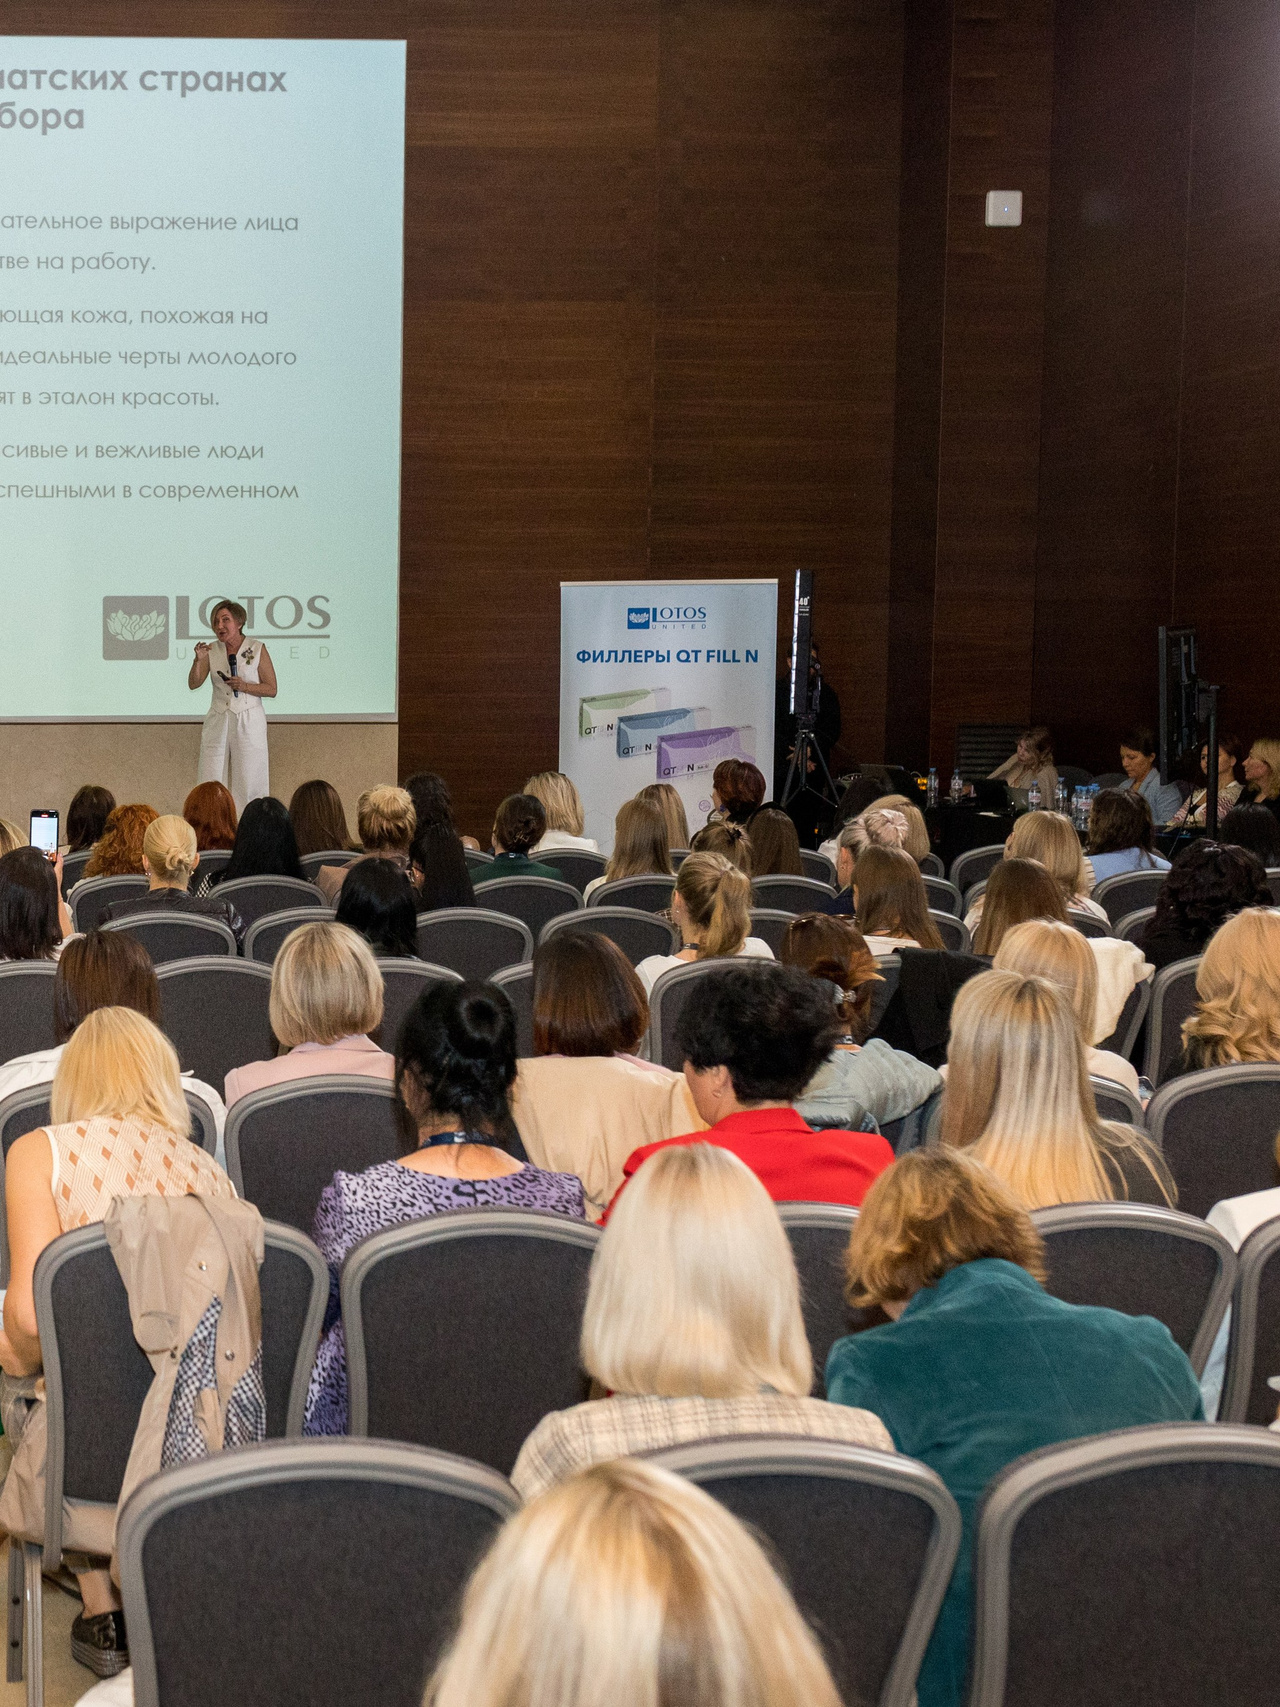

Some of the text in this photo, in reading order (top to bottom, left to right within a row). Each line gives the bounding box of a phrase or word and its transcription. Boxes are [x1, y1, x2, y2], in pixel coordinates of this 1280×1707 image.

[139, 70, 287, 98] странах
[110, 216, 237, 235] выражение
[244, 217, 298, 233] лица
[37, 256, 64, 269] на
[72, 251, 155, 274] работу.
[71, 310, 132, 325] кожа,
[141, 310, 234, 324] похожая
[241, 311, 268, 324] на
[118, 352, 180, 369] черты
[187, 352, 297, 367] молодого
[22, 392, 32, 405] в
[39, 392, 114, 405] эталон
[122, 392, 219, 409] красоты.
[76, 445, 88, 458] и
[95, 445, 200, 458] вежливые
[207, 445, 264, 460] люди
[123, 485, 132, 498] в
[139, 485, 299, 502] современном
[652, 606, 707, 622] LOTOS
[576, 650, 758, 663] ФИЛЛЕРЫ QT FILL N
